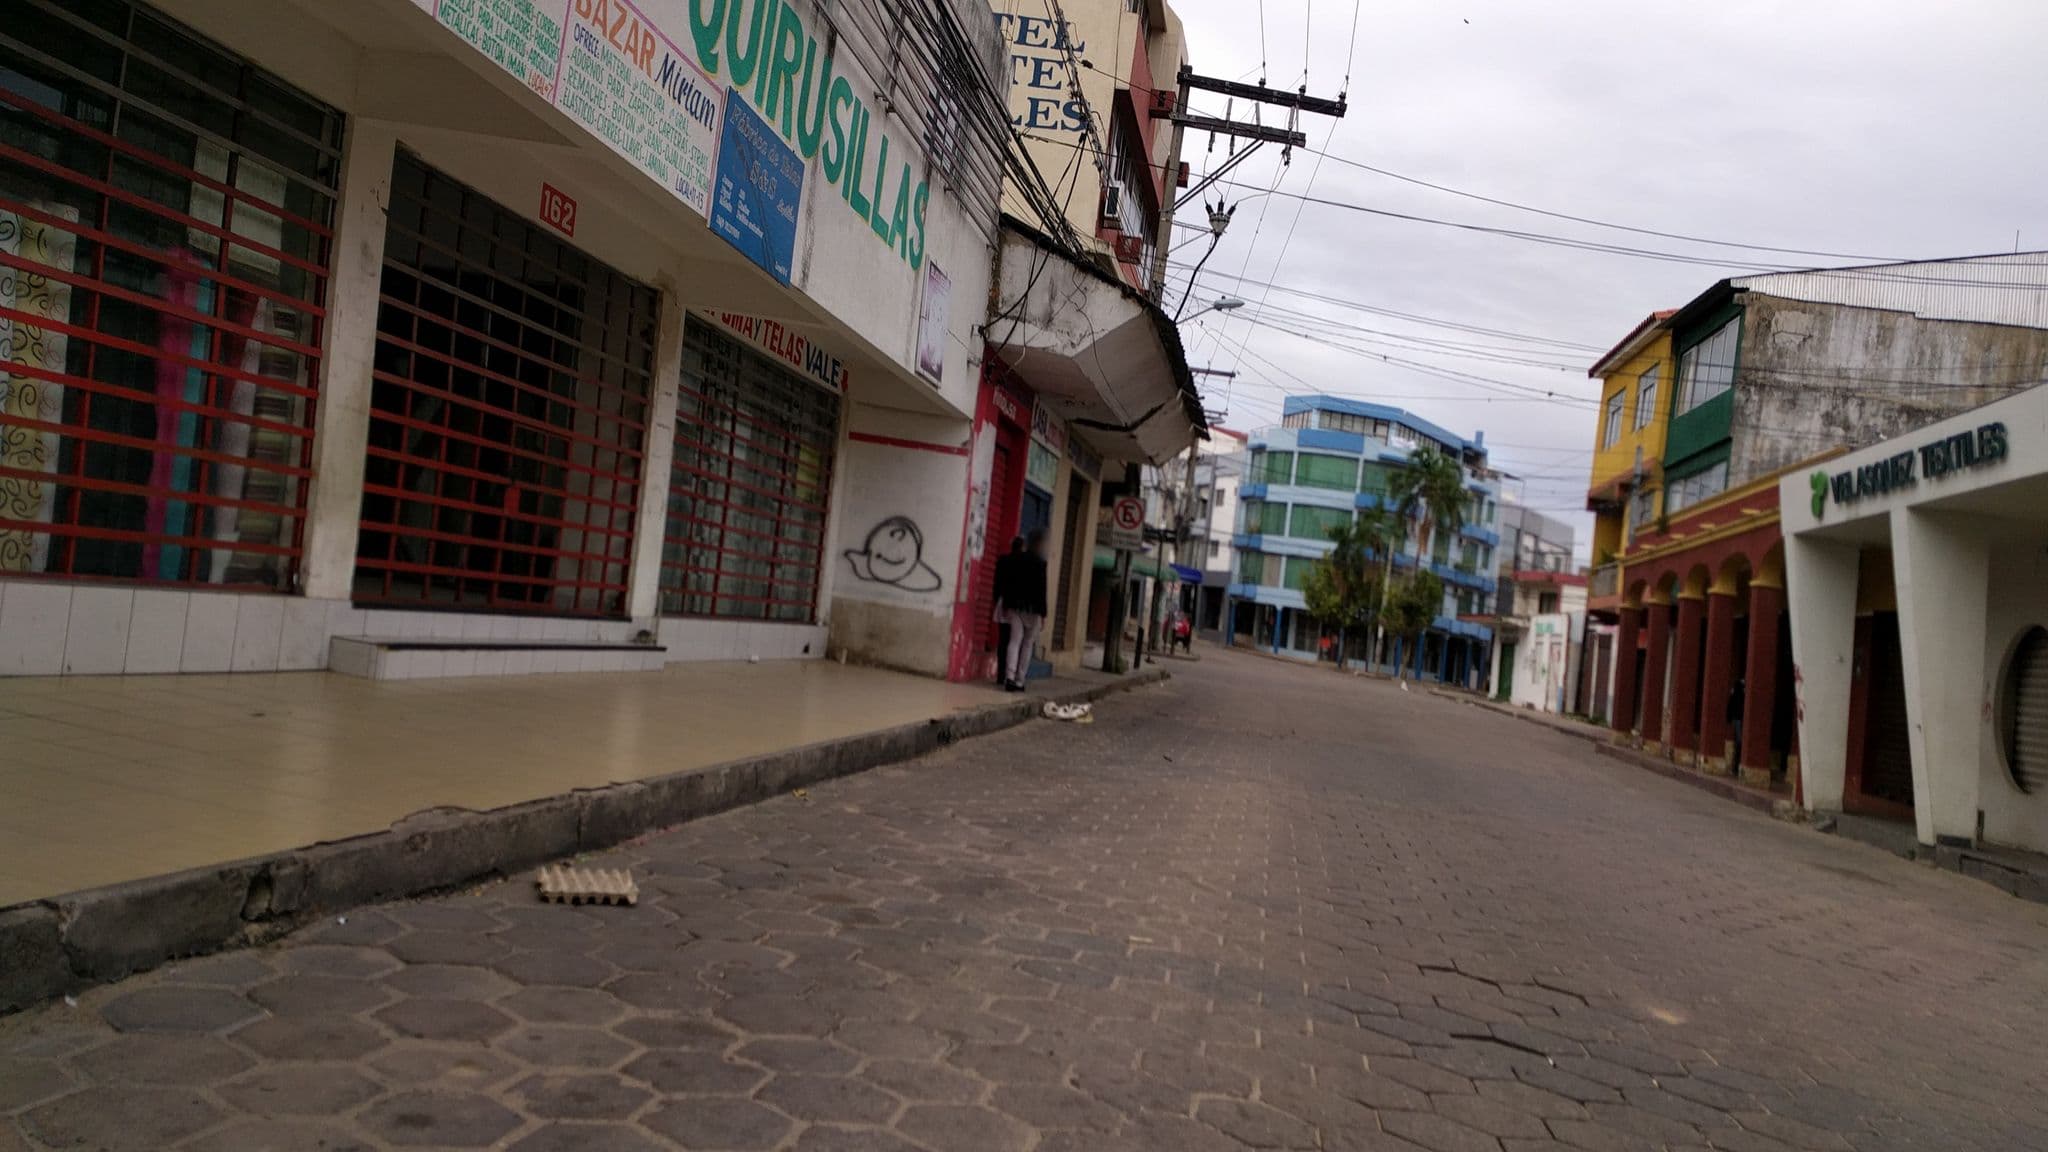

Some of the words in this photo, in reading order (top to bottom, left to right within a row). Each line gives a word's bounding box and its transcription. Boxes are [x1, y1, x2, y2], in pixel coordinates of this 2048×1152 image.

[481, 32, 505, 64] BOTON
[607, 74, 625, 102] PARA
[654, 51, 715, 132] Miriam
[611, 101, 636, 133] BOTON
[688, 0, 930, 271] QUIRUSILLAS
[544, 190, 573, 232] 162
[763, 319, 805, 368] TELAS
[805, 340, 841, 388] VALE
[1918, 421, 2009, 478] TEXTILES
